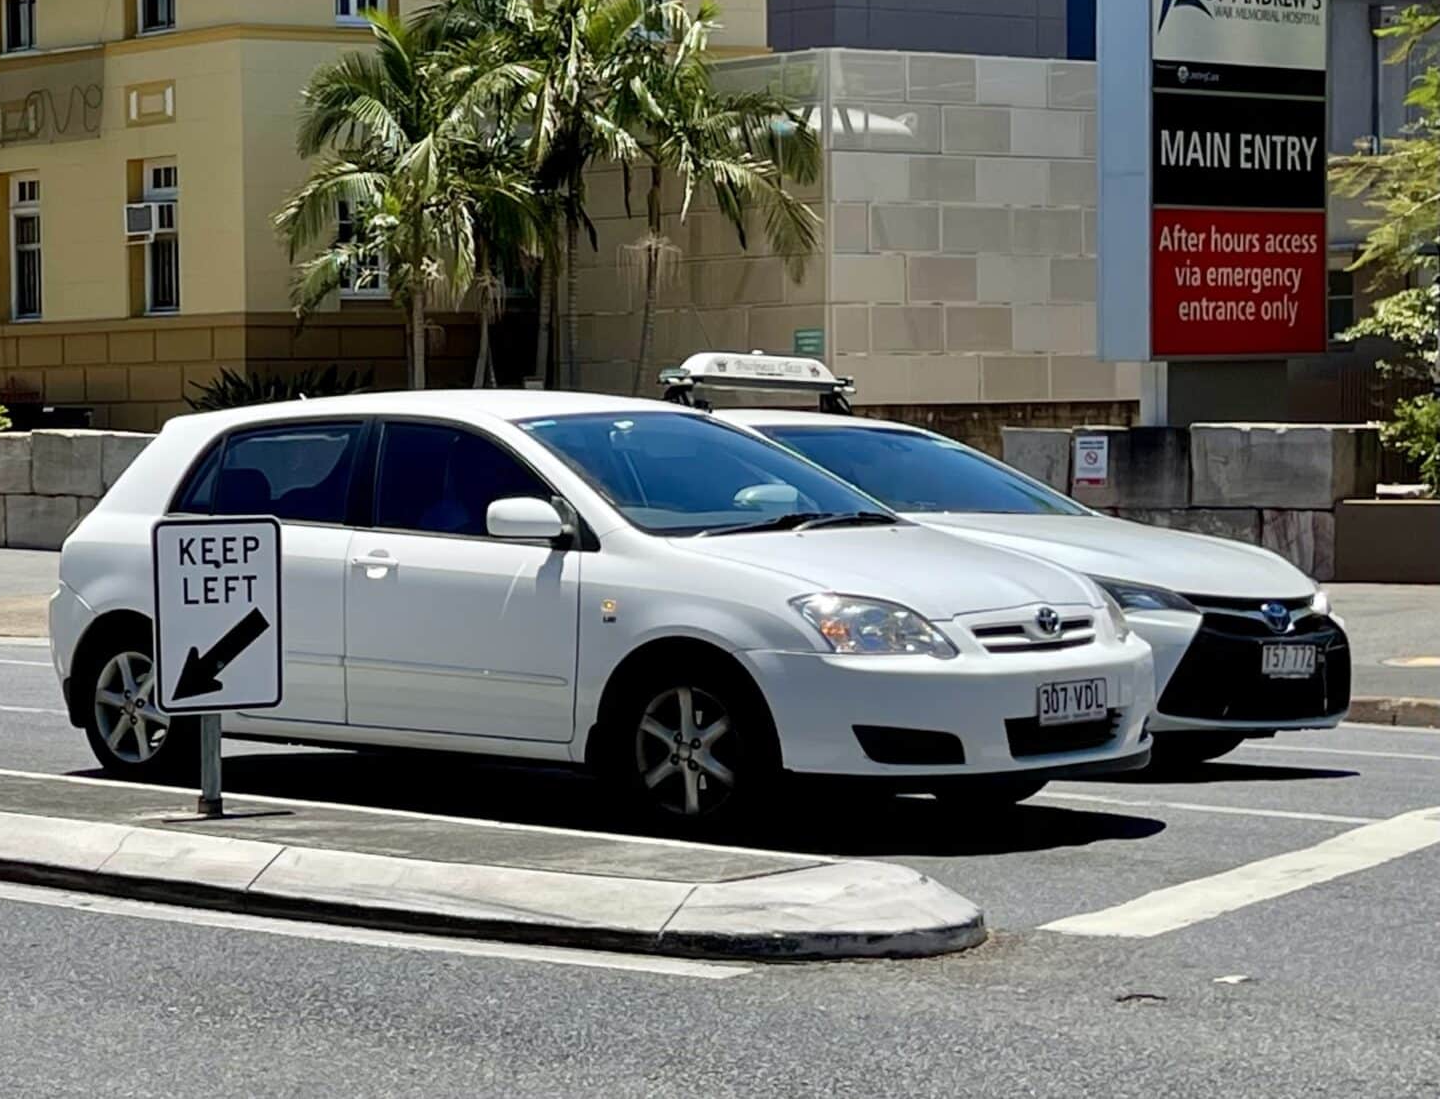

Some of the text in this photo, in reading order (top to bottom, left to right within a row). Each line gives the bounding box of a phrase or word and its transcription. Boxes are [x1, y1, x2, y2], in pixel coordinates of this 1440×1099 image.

[1160, 129, 1317, 172] MAIN ENTRY
[1159, 224, 1318, 254] After hours access
[1175, 259, 1303, 294] via emergency
[1178, 293, 1299, 327] entrance only
[179, 536, 259, 566] KEEP
[183, 575, 257, 604] LEFT
